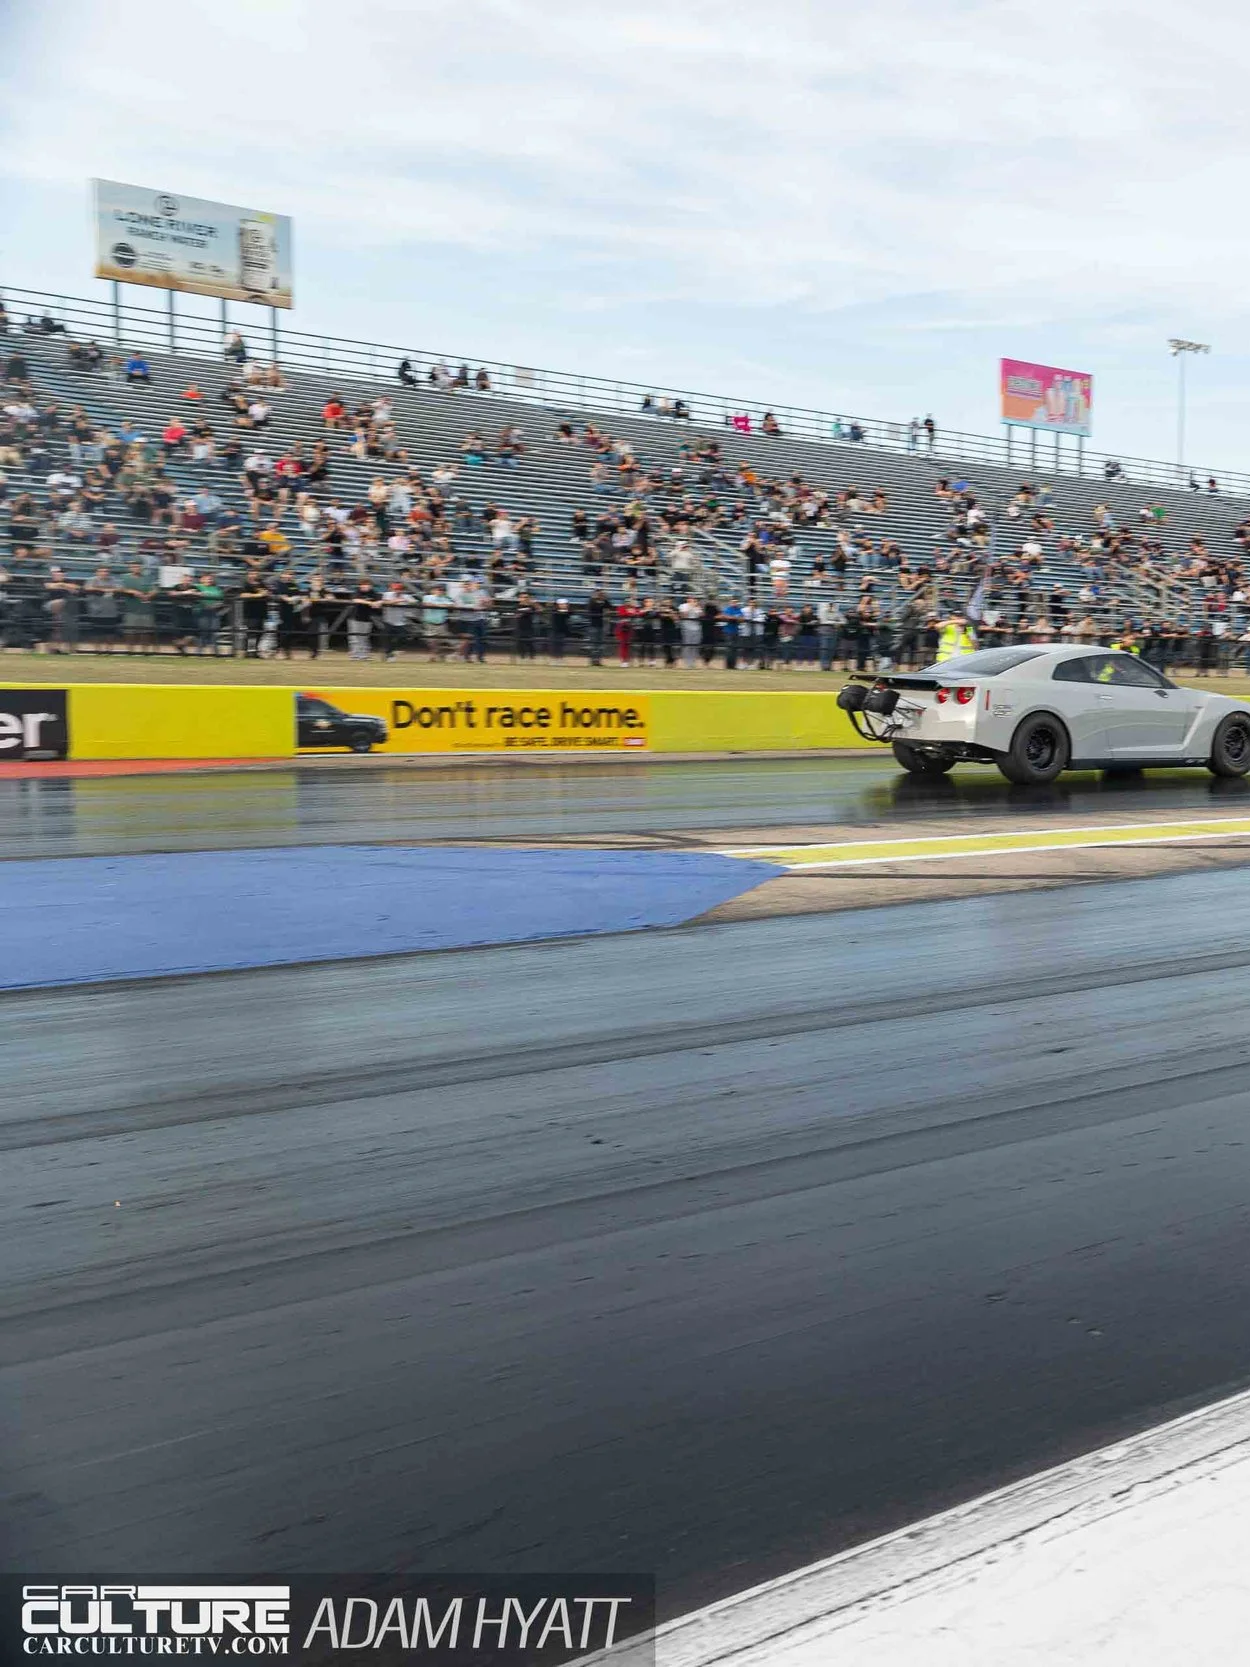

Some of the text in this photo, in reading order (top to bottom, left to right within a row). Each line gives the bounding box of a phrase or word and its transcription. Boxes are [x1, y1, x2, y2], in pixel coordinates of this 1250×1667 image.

[393, 699, 645, 729] Don't race home.
